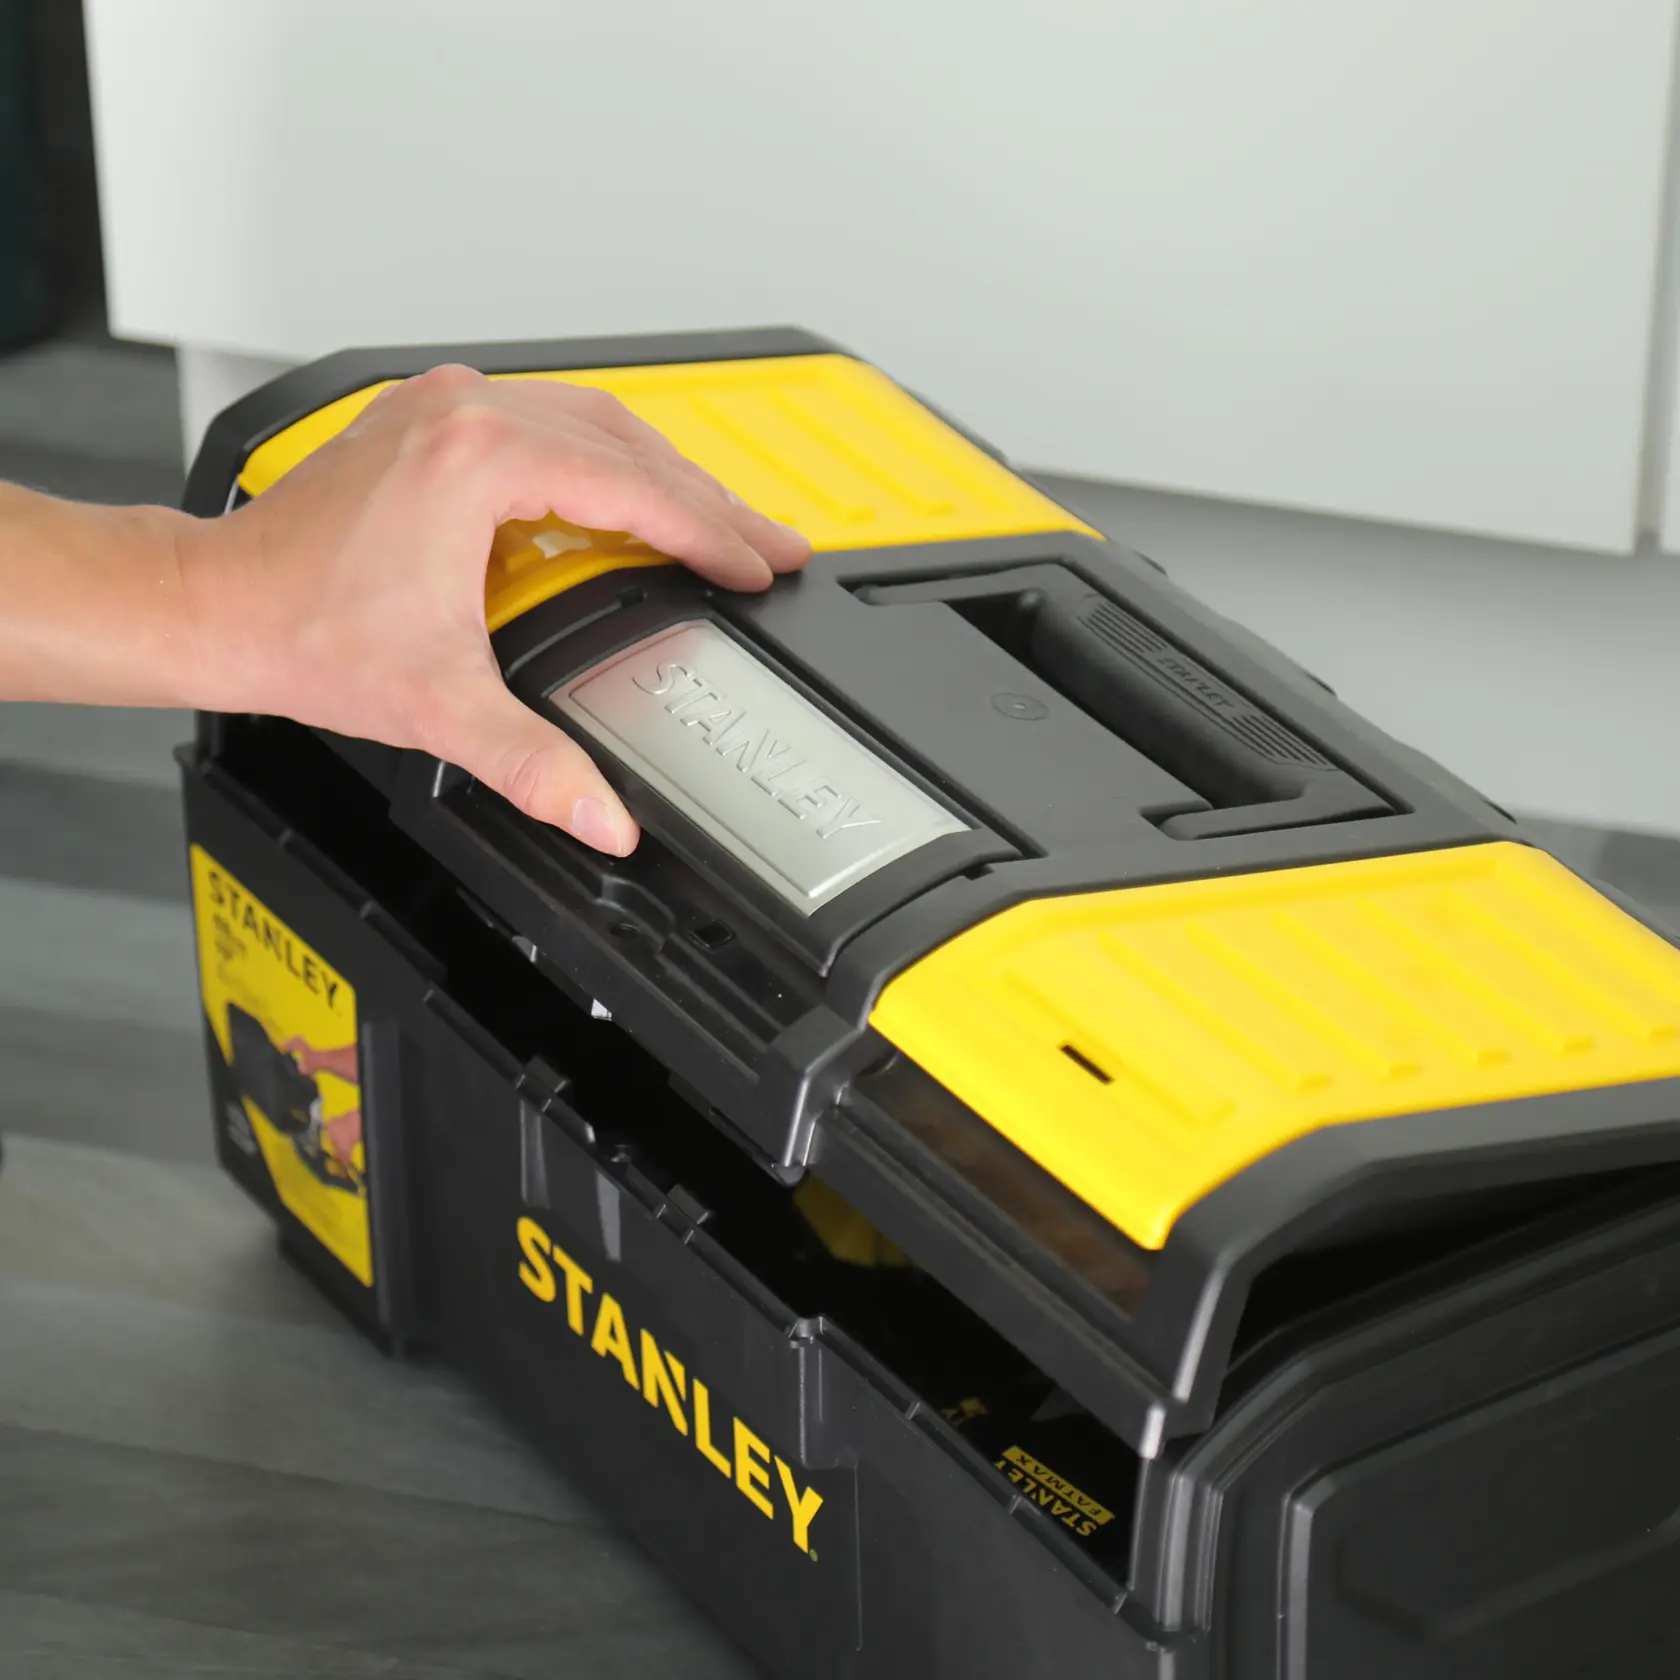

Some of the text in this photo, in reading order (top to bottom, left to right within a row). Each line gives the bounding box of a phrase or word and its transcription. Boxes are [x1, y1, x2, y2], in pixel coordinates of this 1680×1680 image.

[632, 661, 882, 839] STANLEY
[1156, 656, 1235, 709] STANLEY
[208, 868, 339, 1011] STANLEY
[516, 1216, 824, 1554] STANLEY
[1016, 1453, 1103, 1517] FATMAX
